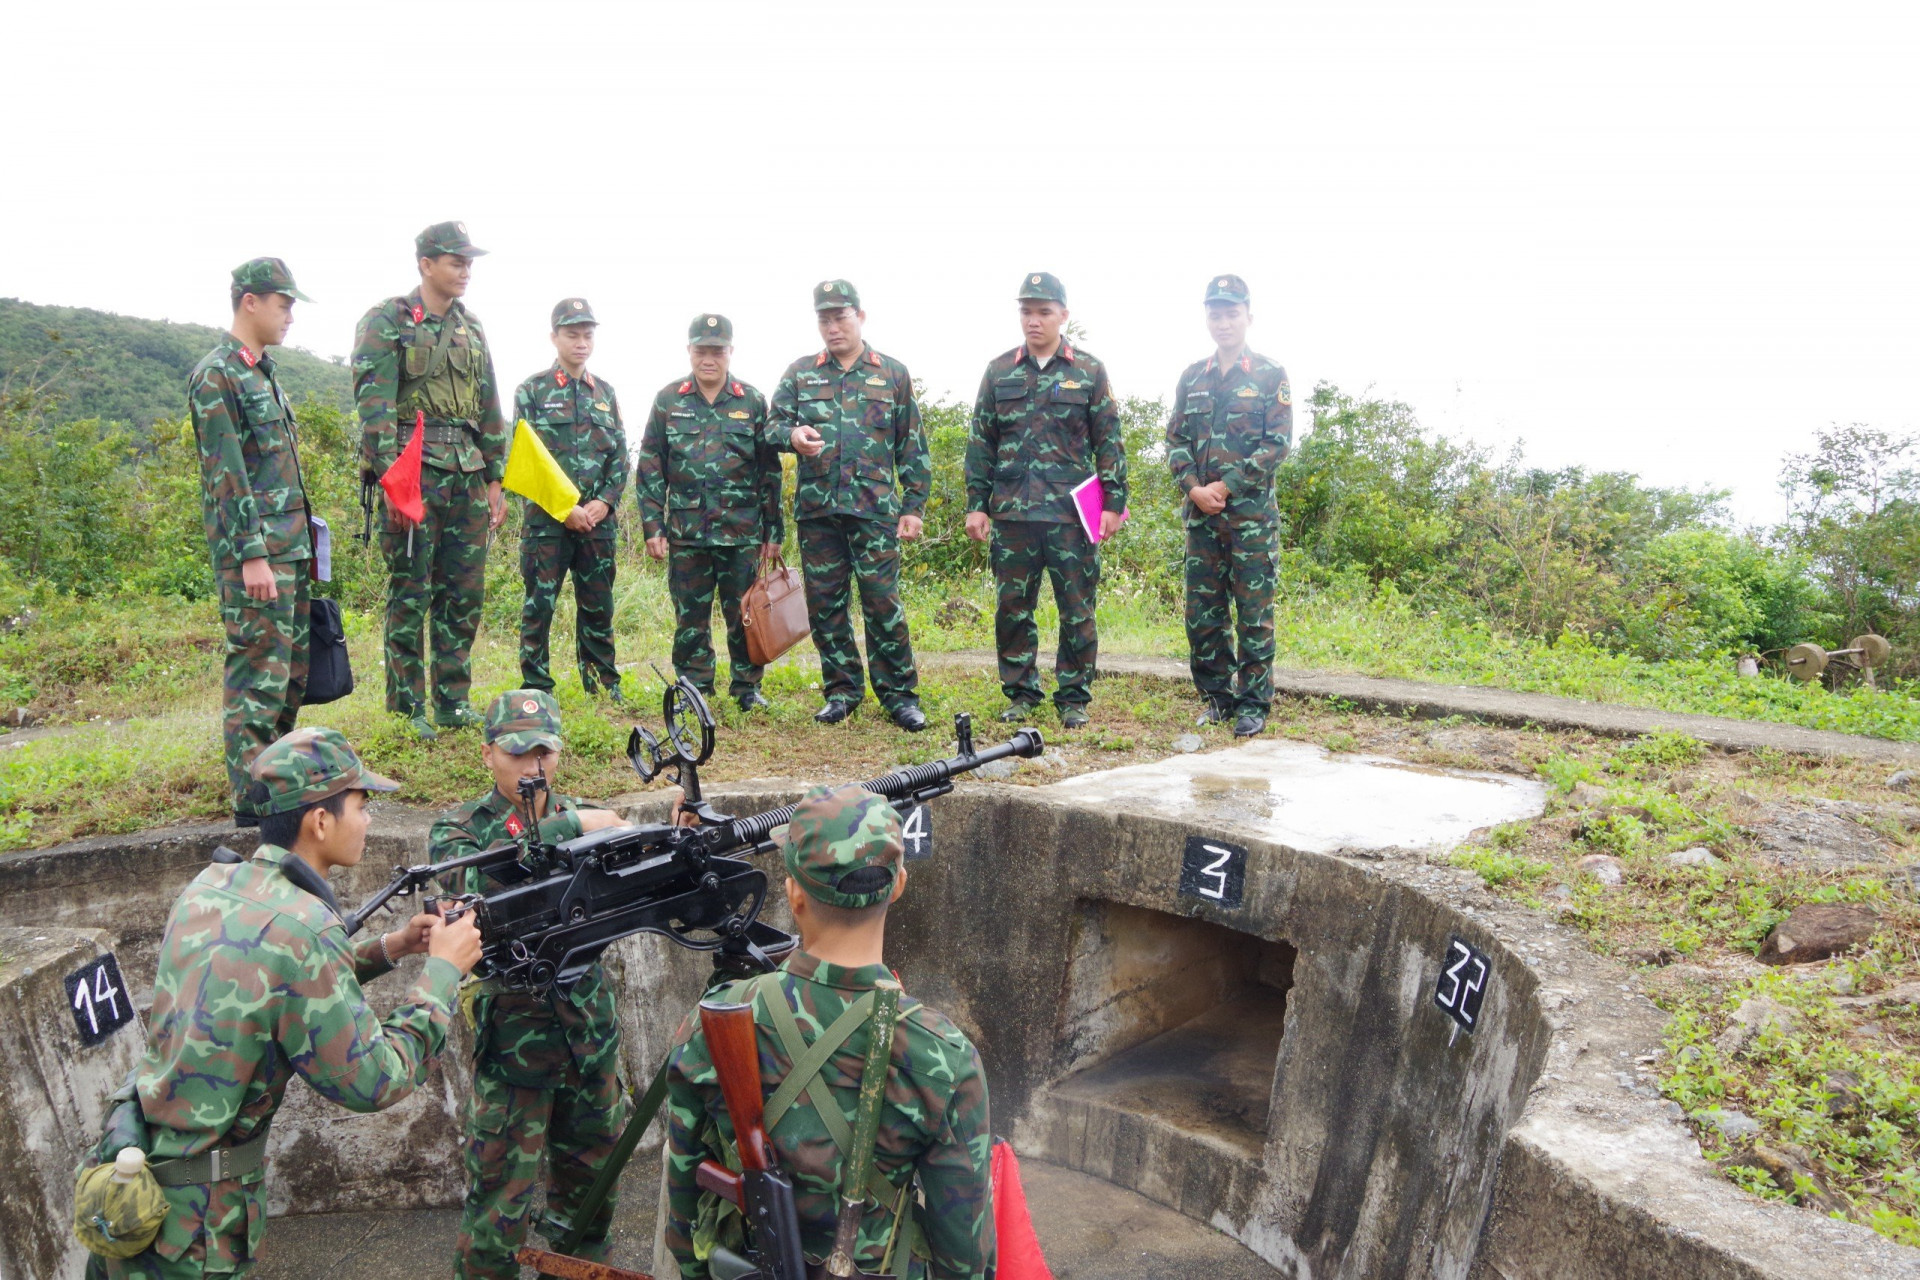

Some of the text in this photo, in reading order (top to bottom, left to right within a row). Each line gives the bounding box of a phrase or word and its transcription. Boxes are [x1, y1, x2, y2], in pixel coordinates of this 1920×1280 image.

[1199, 844, 1232, 899] 3
[74, 964, 119, 1035] 14
[1437, 940, 1486, 1024] 32
